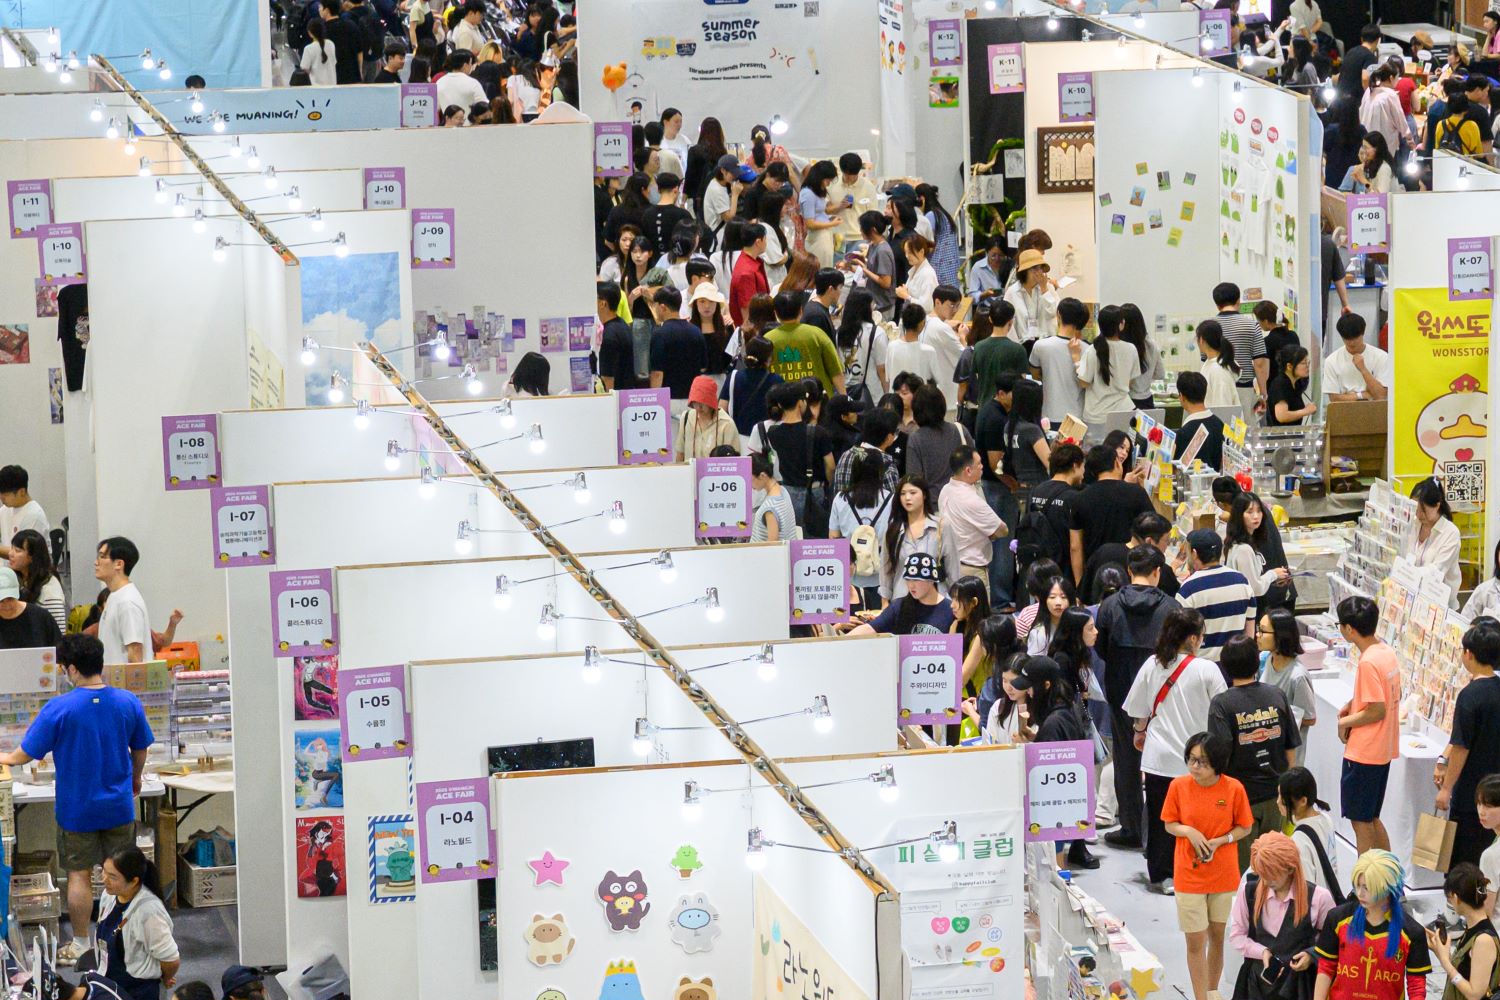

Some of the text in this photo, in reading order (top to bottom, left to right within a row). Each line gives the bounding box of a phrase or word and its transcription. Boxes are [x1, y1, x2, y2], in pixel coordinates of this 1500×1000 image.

[702, 18, 760, 31] summer
[705, 30, 756, 42] season
[410, 99, 427, 107] J-12
[184, 109, 299, 124] WE MUANING!
[23, 197, 39, 205] I-11
[1358, 212, 1380, 220] K-08
[421, 227, 443, 235] J-09
[53, 242, 71, 251] I-10
[1459, 257, 1482, 265] K-07
[1432, 347, 1489, 357] WONSSTOR
[631, 412, 657, 422] J-07
[180, 438, 205, 448] I-08
[708, 482, 737, 492] J-06
[230, 511, 255, 522] I-07
[804, 566, 834, 577] J-05
[290, 597, 319, 608] I-06
[912, 663, 946, 674] J-04
[372, 676, 391, 684] FAIR
[360, 695, 390, 709] I-05
[1235, 706, 1279, 725] Kodak
[1041, 772, 1076, 785] J-03
[436, 791, 475, 801] ACE FAIR
[440, 810, 473, 825] I-04
[972, 837, 1013, 860] 클럽
